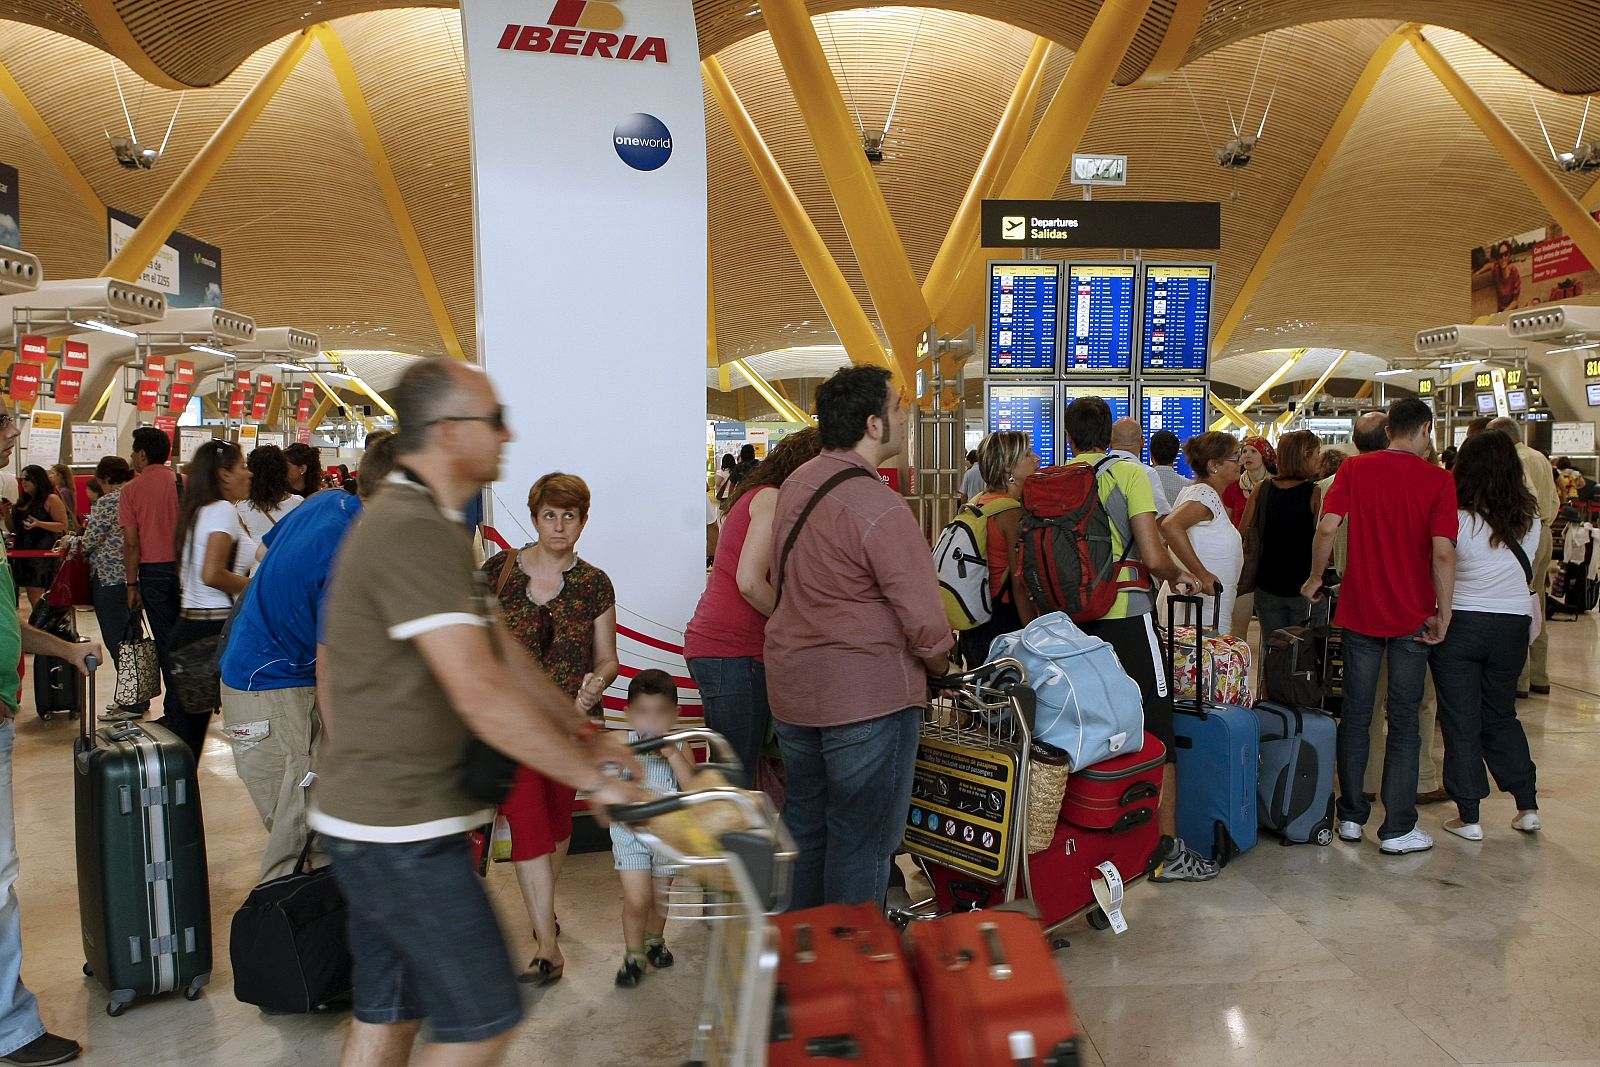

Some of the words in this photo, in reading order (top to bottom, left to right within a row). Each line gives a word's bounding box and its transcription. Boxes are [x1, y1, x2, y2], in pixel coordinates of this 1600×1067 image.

[497, 24, 667, 63] IBERIA
[615, 136, 671, 149] oneworld
[1031, 217, 1079, 229] Departures
[1031, 229, 1068, 240] Salidas
[1476, 374, 1490, 387] 818
[1507, 370, 1521, 384] 817
[1419, 380, 1431, 393] 819
